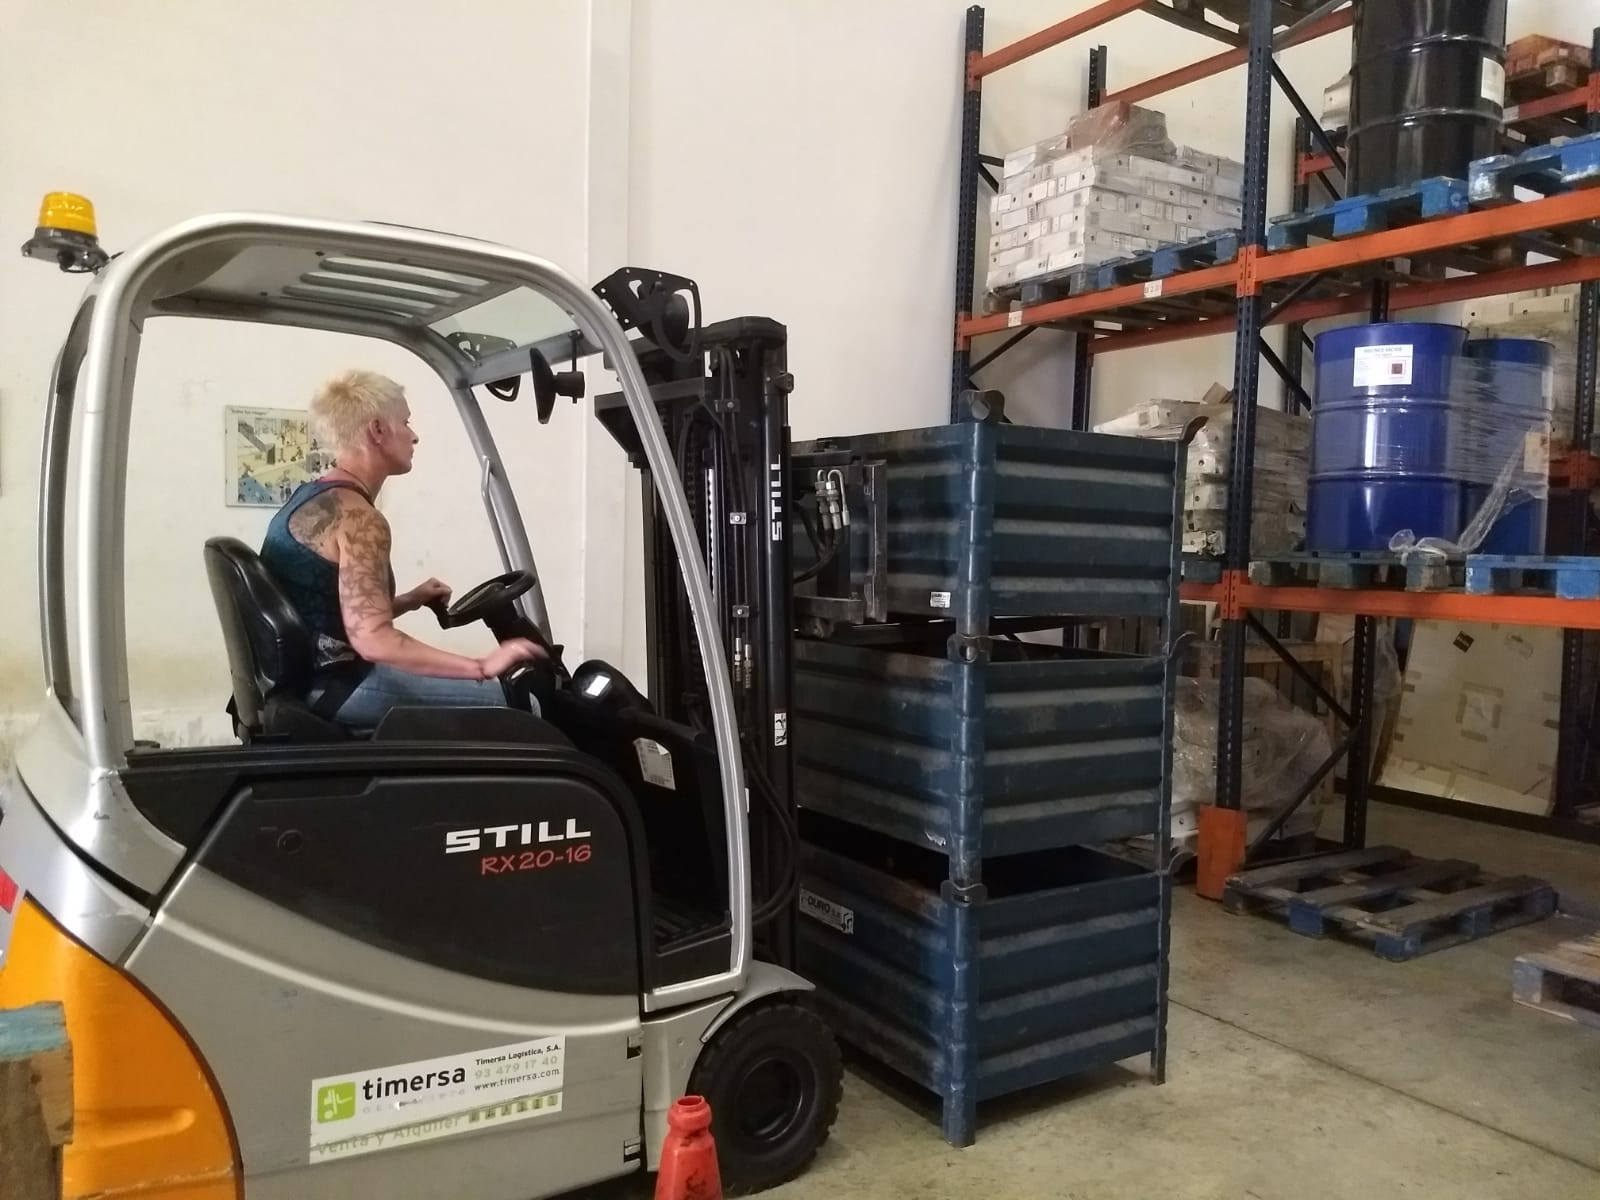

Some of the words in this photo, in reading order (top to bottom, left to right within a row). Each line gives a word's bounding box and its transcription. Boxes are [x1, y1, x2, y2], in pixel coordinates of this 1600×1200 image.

[770, 453, 782, 541] STILL
[445, 818, 592, 854] STILL
[475, 1055, 506, 1066] Timersa
[475, 1068, 491, 1080] 93
[495, 1063, 520, 1075] 479
[524, 1059, 537, 1070] 17
[541, 1055, 558, 1065] 40
[362, 1066, 466, 1101] timersa
[474, 1068, 560, 1091] www.timersa.com
[374, 1133, 385, 1147] y
